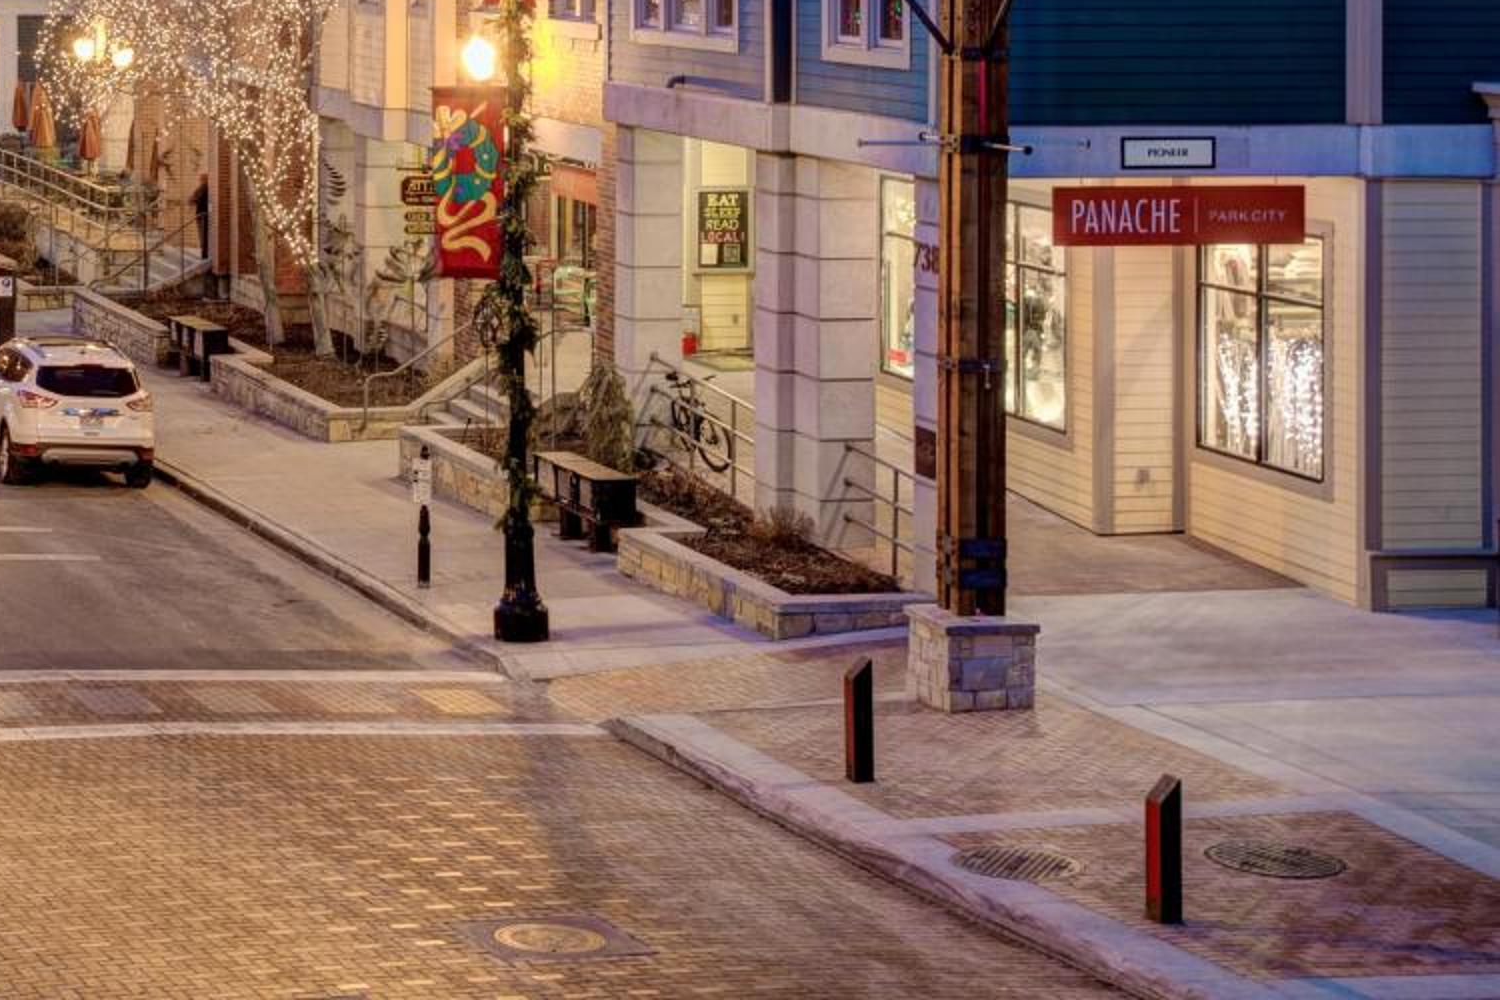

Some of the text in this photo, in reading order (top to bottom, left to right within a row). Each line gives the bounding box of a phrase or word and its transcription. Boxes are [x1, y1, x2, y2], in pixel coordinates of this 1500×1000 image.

[707, 193, 739, 207] EAT
[1071, 199, 1286, 233] PANACHE PARK CITY
[706, 219, 739, 231] READ
